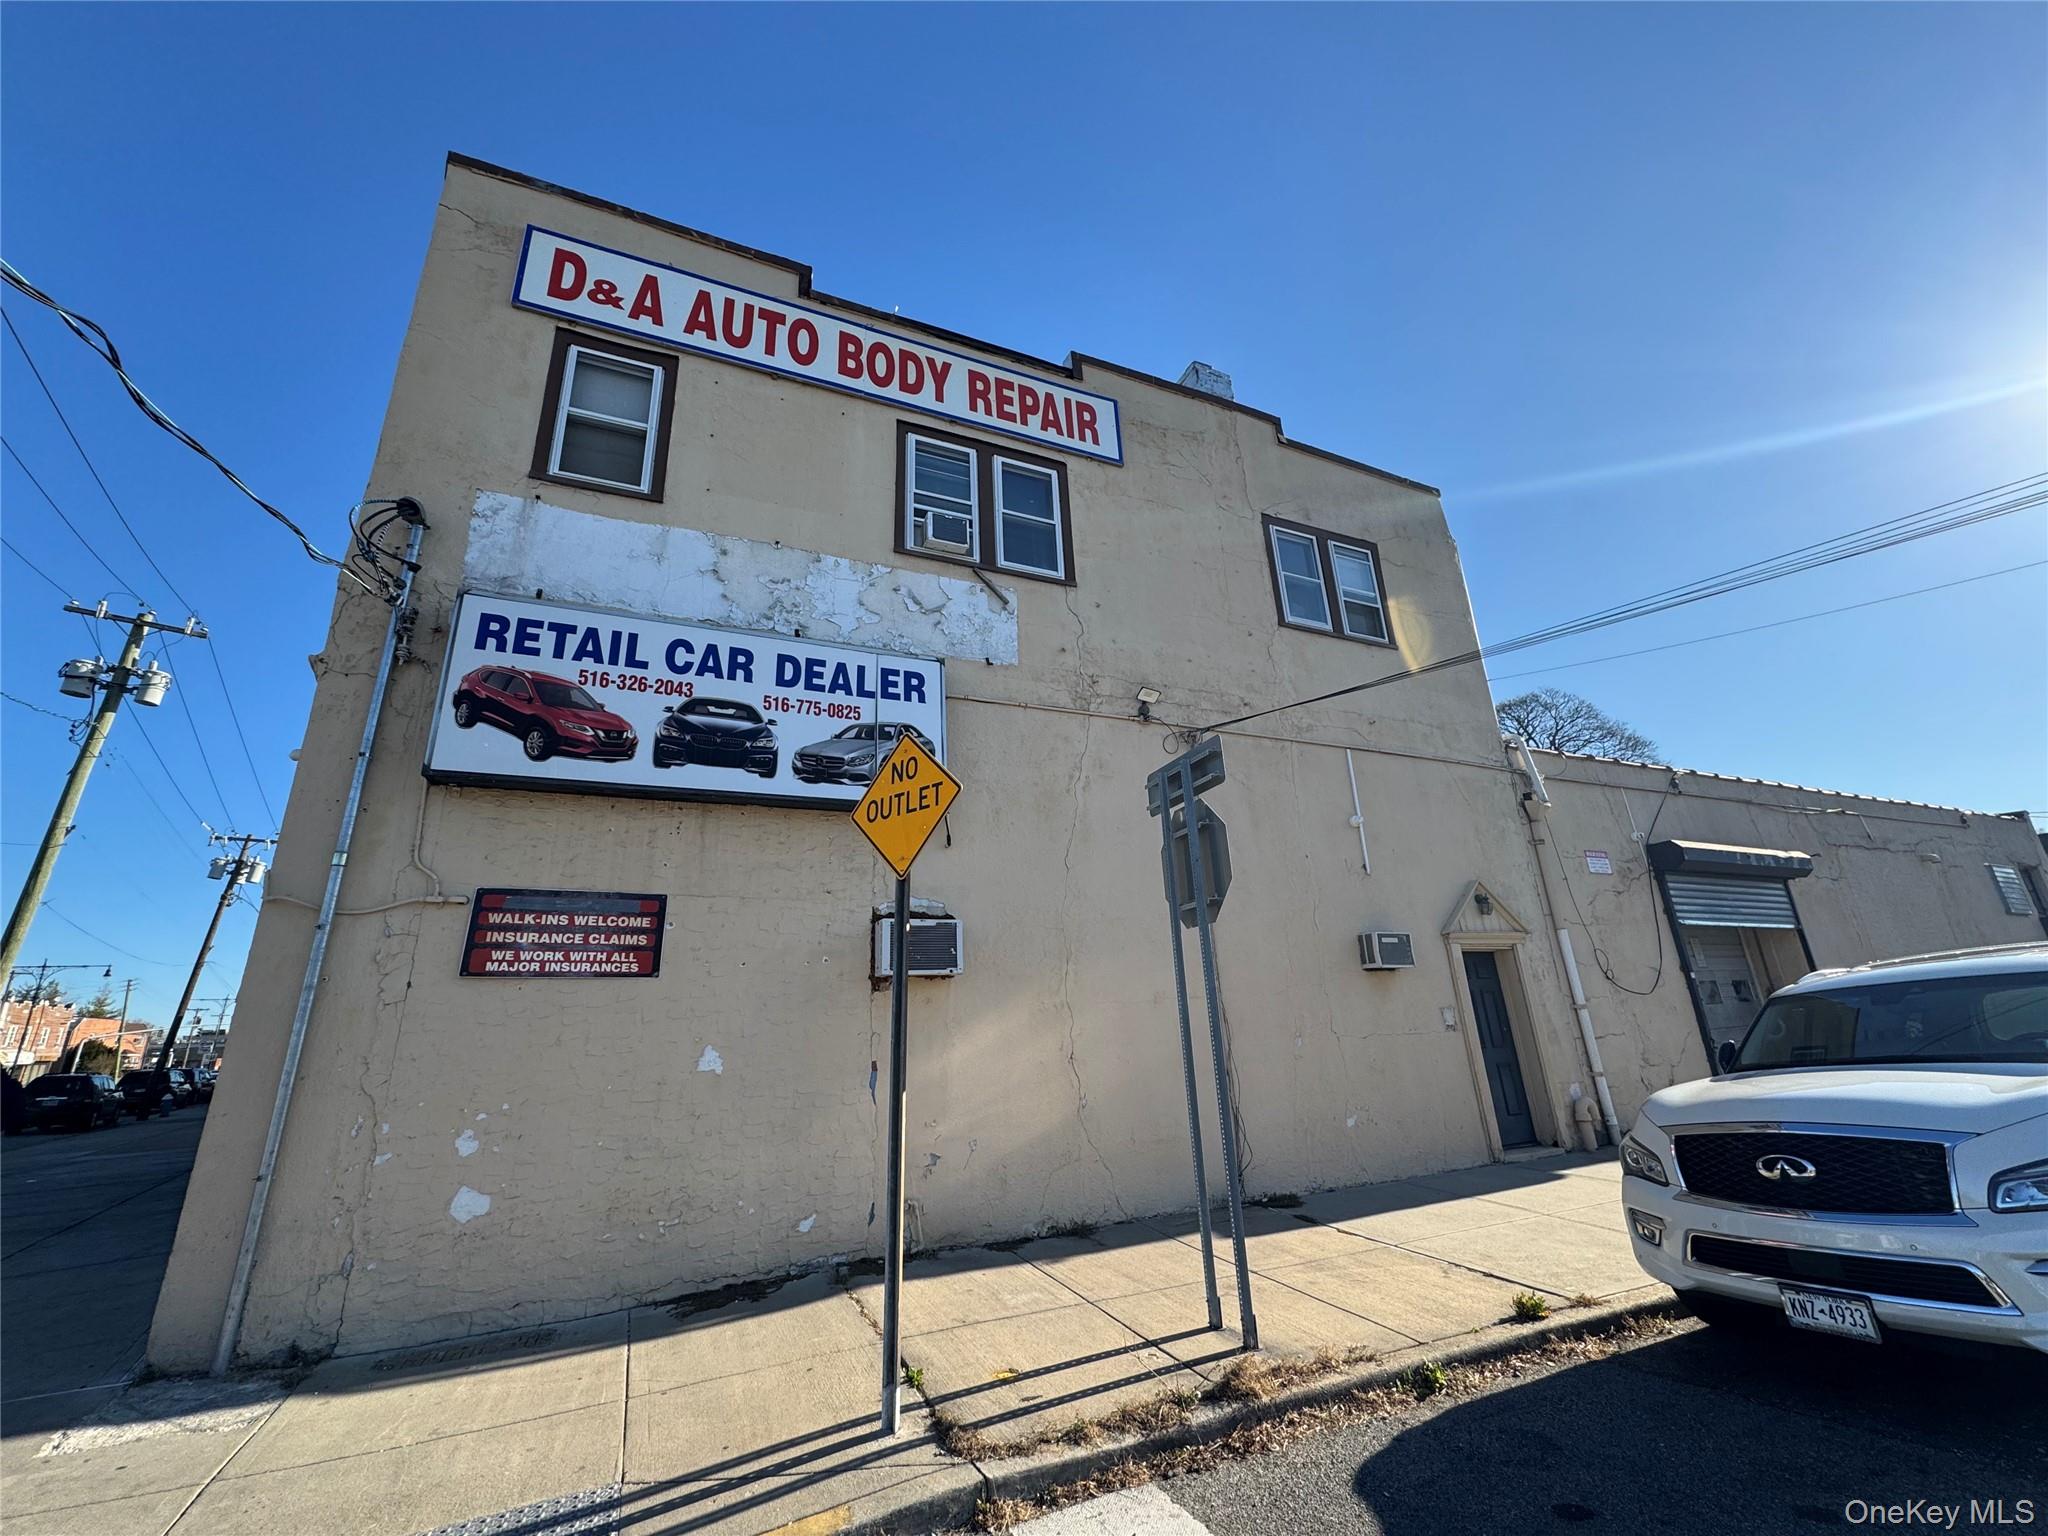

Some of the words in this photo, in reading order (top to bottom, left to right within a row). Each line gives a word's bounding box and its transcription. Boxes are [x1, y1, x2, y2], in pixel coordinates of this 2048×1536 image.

[546, 247, 664, 327] D&A
[683, 290, 820, 366] AUTO
[837, 329, 952, 405] BODY
[967, 368, 1101, 446] REPAIR
[473, 612, 649, 670] RETAIL
[664, 638, 754, 684] CAR
[775, 652, 927, 704] DEALER
[577, 669, 694, 698] 516-326-2043
[763, 694, 861, 721] 516-775-0825
[891, 756, 918, 784] NO
[866, 781, 944, 823] OUTLET
[488, 913, 569, 926] WALK-INS
[574, 915, 651, 928] WELCOME
[486, 932, 584, 944] INSURANCE
[588, 934, 648, 945] CLAIMS
[485, 962, 540, 972] MAJOR
[544, 962, 640, 972] INSURANCES
[491, 950, 515, 961] WE
[519, 951, 565, 961] WORK
[570, 951, 607, 962] WITH
[610, 952, 637, 962] ALL
